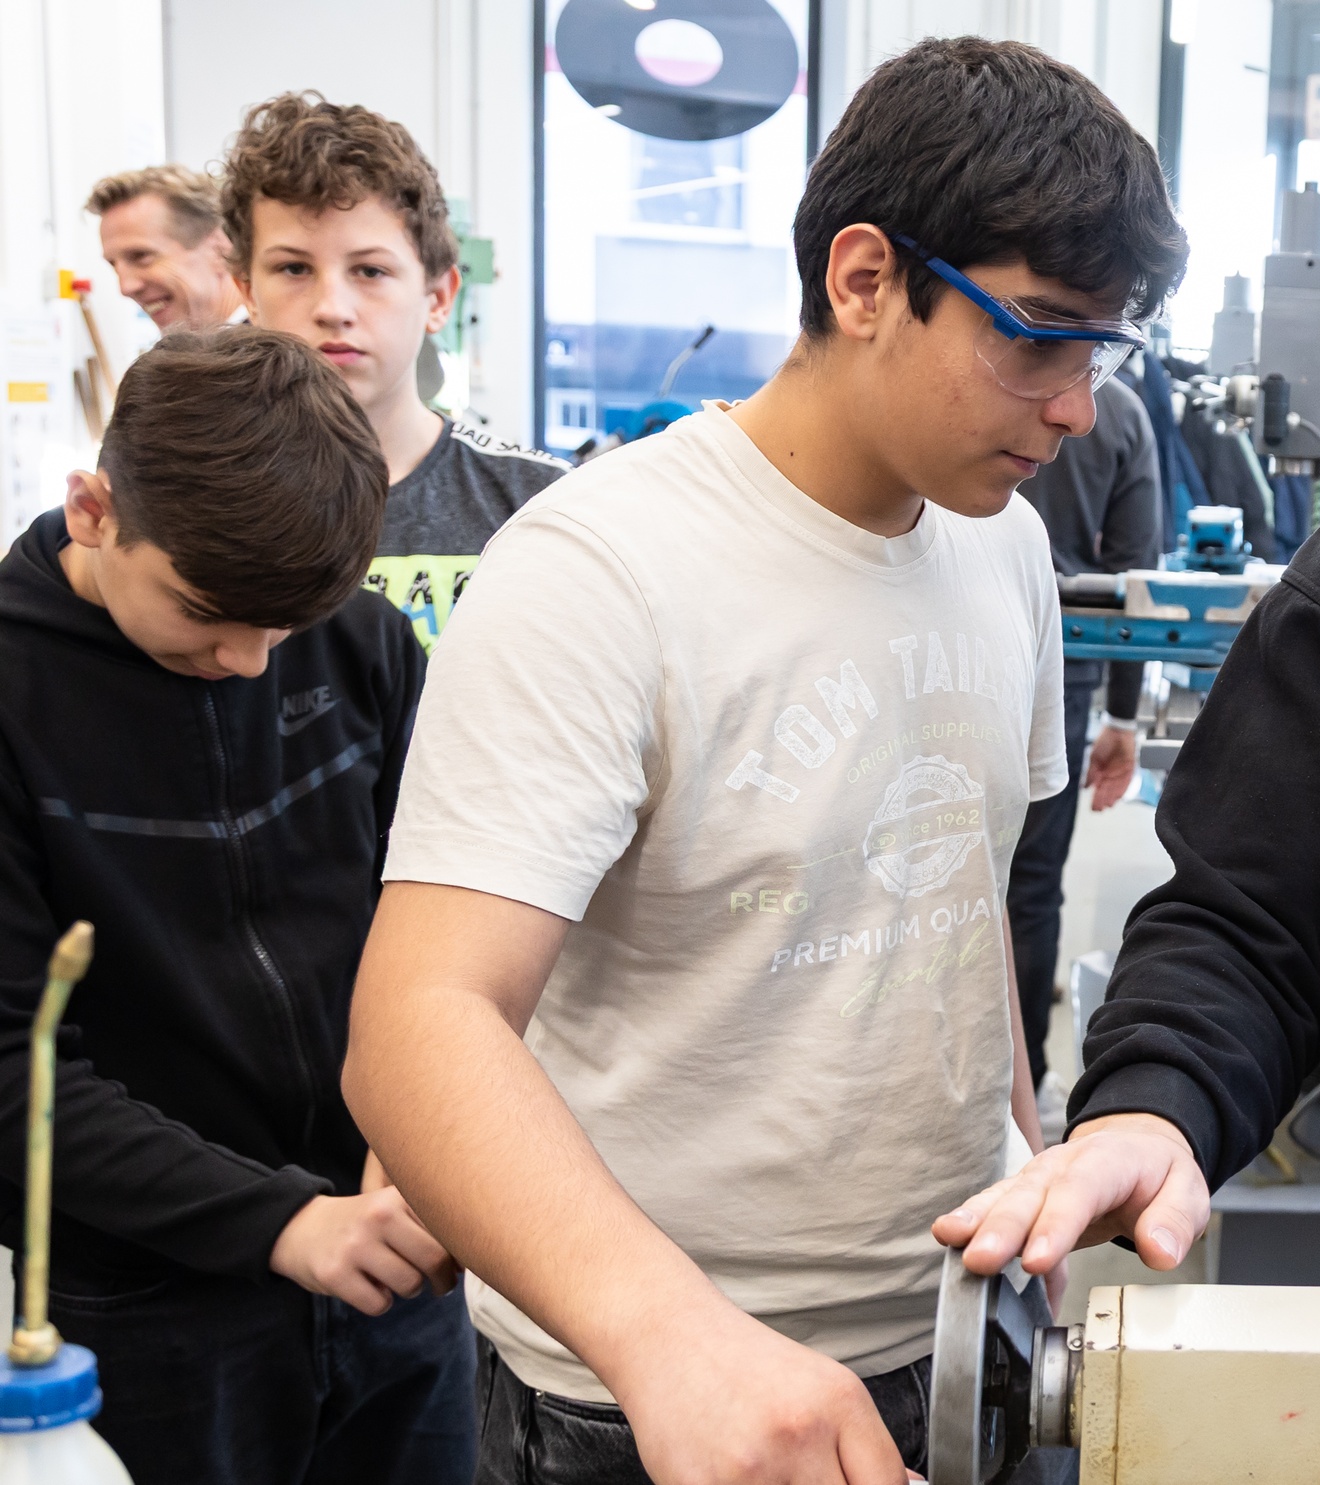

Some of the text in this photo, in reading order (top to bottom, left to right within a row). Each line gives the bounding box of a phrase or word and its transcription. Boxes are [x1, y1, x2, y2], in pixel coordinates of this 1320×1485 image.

[282, 685, 330, 717] NIKE
[725, 632, 1022, 804] TOM TAILO
[846, 722, 1004, 785] ORIGINAL SUPPLIES
[936, 808, 980, 831] 1962
[730, 889, 810, 915] REG
[770, 914, 921, 973] PREMIUM
